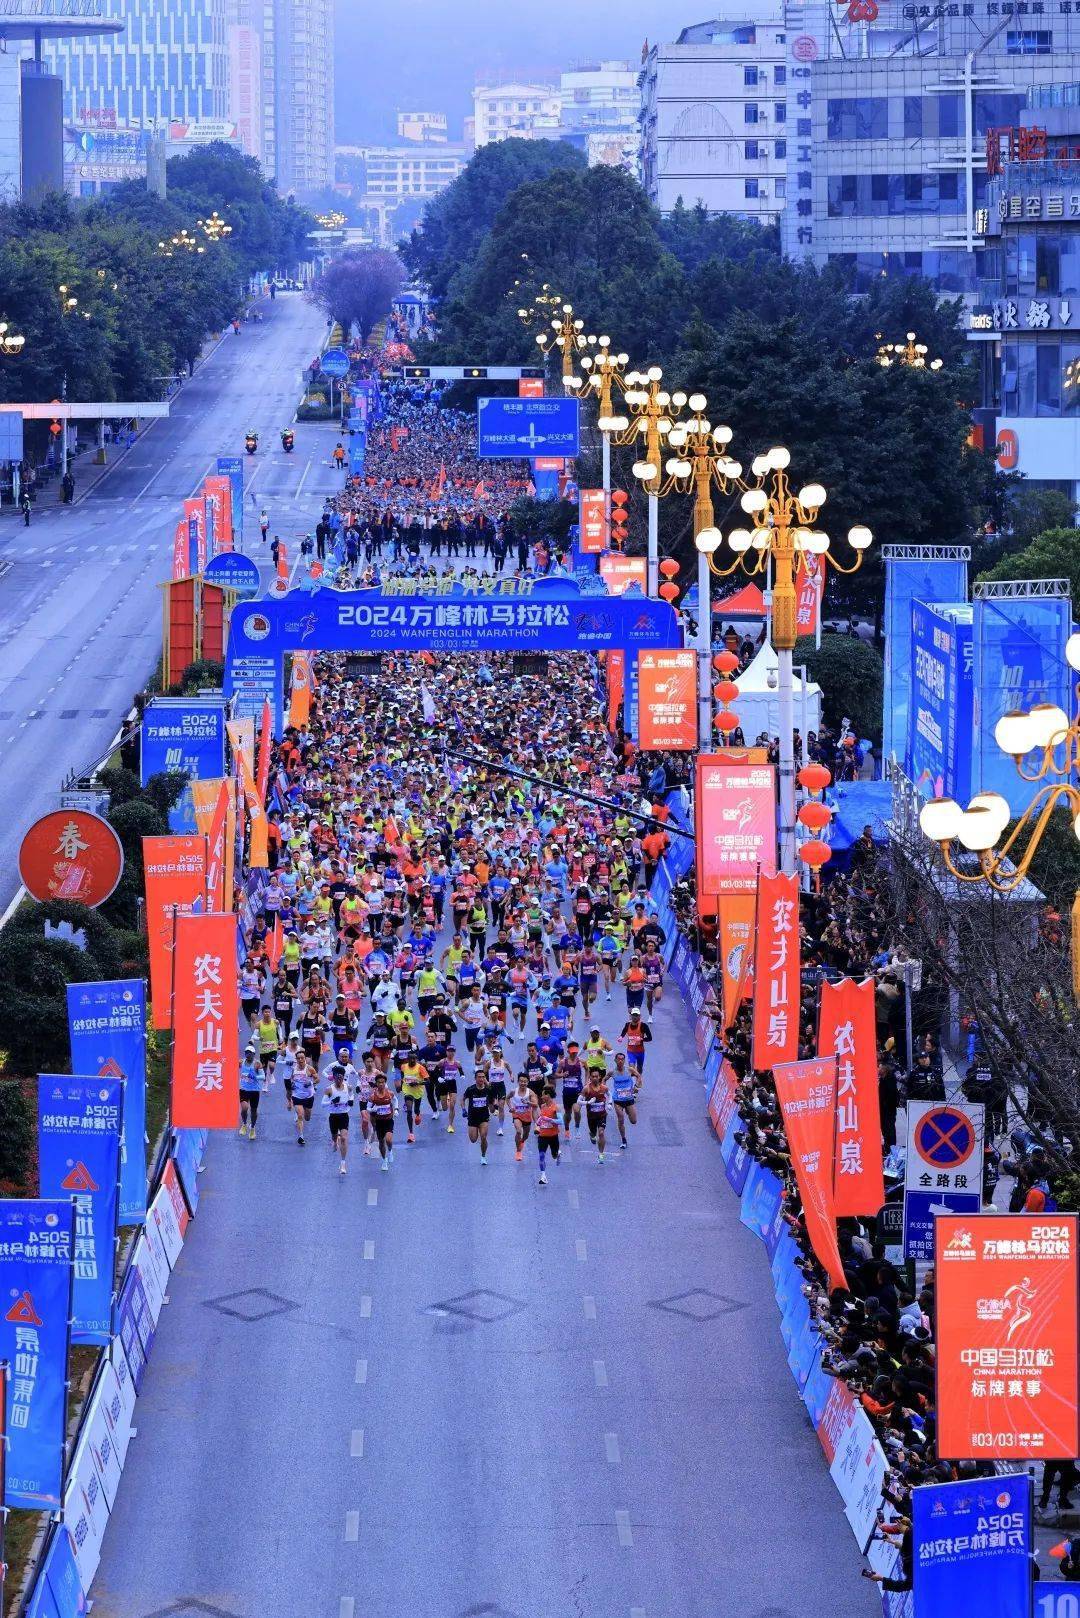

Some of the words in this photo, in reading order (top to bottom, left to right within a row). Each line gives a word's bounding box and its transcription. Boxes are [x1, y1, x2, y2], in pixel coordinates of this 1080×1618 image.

[338, 604, 570, 627] 2024万峰林马拉松
[371, 629, 396, 637] 2024
[401, 629, 472, 637] WANFENGLIN
[477, 629, 539, 637] MARATHON
[182, 715, 218, 726] 2024
[147, 726, 217, 737] 万峰林马拉松
[53, 820, 91, 860] 春
[193, 953, 223, 1091] 农夫山泉
[919, 1172, 968, 1189] 全路段
[1031, 1226, 1070, 1240] 2024
[908, 1240, 934, 1250] 抓拍区
[982, 1240, 1070, 1255] 万峰林马拉松
[960, 1347, 1055, 1367] 中国马拉松
[973, 1368, 996, 1376] CHINA
[999, 1368, 1042, 1376] MARATHON
[971, 1379, 1042, 1398] 标牌赛事
[978, 1432, 1014, 1447] 03/03
